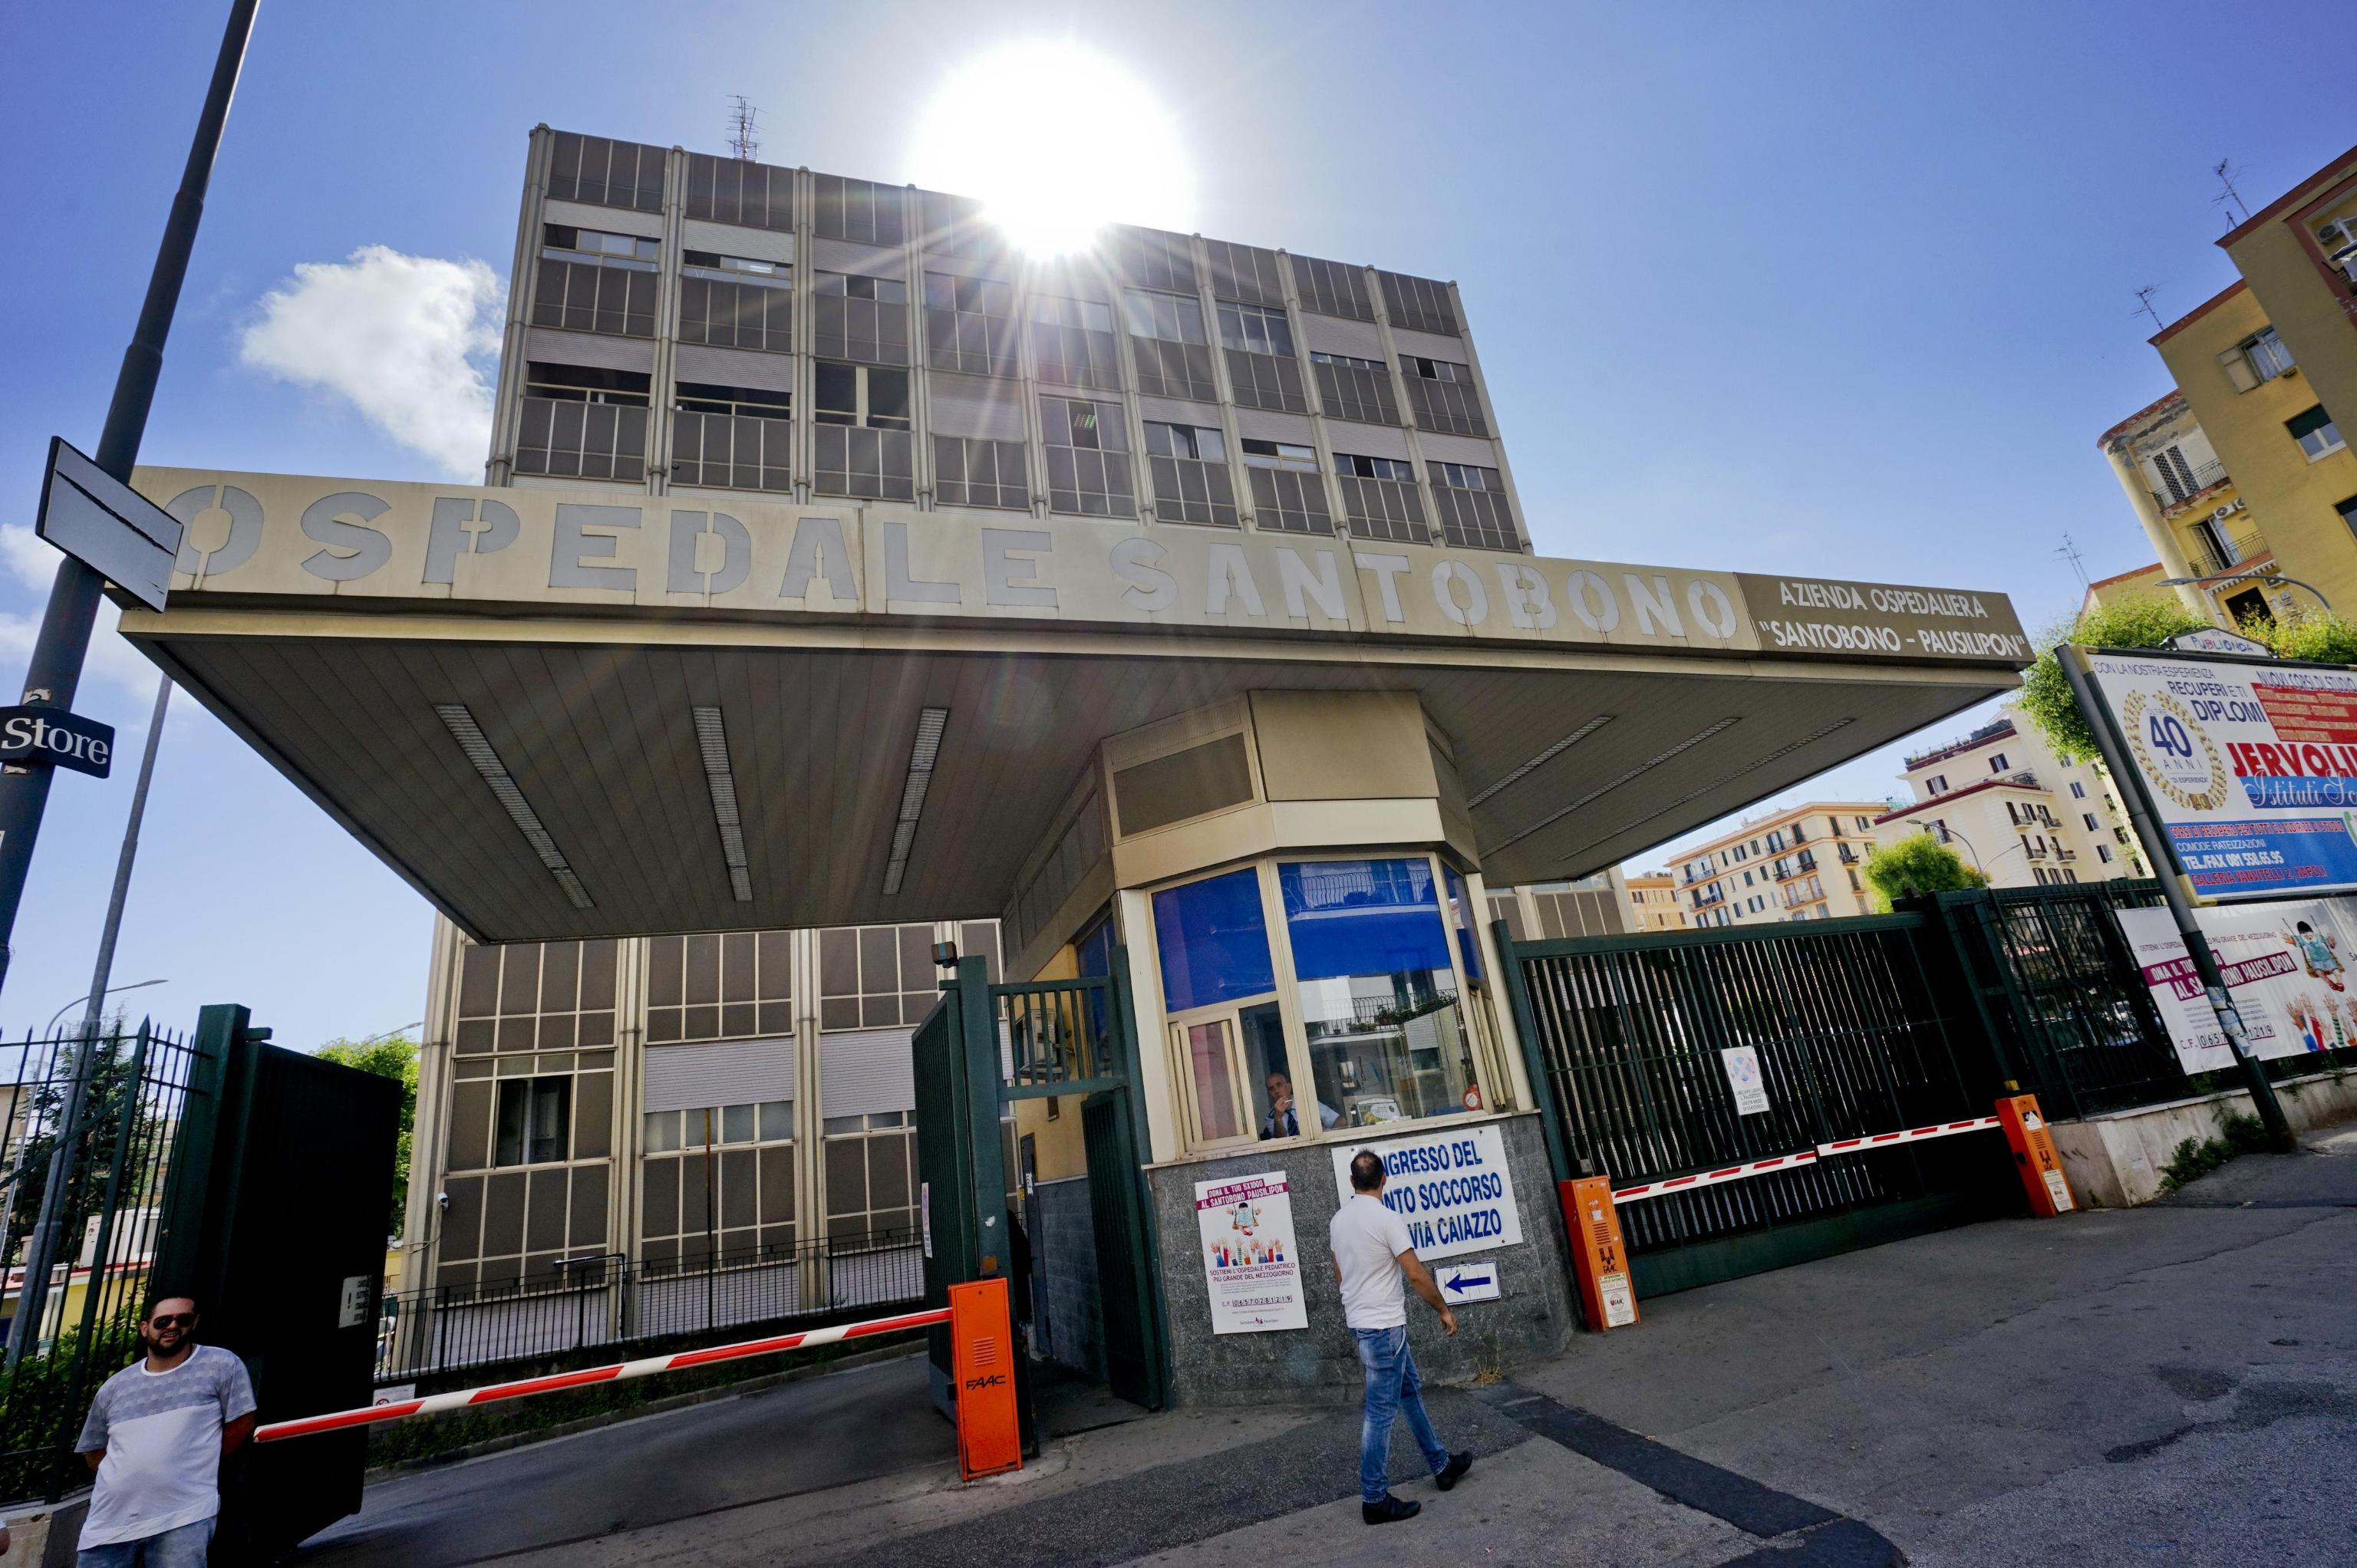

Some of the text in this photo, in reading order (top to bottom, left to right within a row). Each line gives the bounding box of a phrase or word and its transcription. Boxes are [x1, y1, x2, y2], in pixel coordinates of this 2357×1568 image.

[163, 484, 1738, 640] OSPEDALE SANTOBONO
[1779, 581, 1989, 619] AZIENDA OSPEDALIERA
[1759, 621, 1902, 653] "SANTOBONO
[1918, 629, 2025, 657] PAUSILIPON"
[2190, 635, 2254, 652] PUBLIONDA
[2094, 662, 2216, 679] CON LA NOSTRA ESPERIENZA
[2256, 670, 2289, 689] NUOVI
[2288, 674, 2314, 690] CORSI
[2167, 681, 2228, 697] RECUPERI
[2191, 700, 2267, 723] DIPLOMI
[1, 717, 109, 765] Store
[2149, 715, 2193, 758] 40
[2163, 759, 2204, 770] ANNI
[2244, 769, 2322, 805] Istituti
[2170, 825, 2191, 838] CORSI
[2199, 824, 2237, 838] RECUPERO
[2176, 838, 2266, 852] COMODE RATEIZZAZIONI
[2225, 853, 2244, 868] 081
[2191, 871, 2237, 886] GALLERIA
[2234, 868, 2284, 884] VANVITELLI
[2295, 865, 2328, 879] NAPOLI
[2170, 963, 2183, 977] IL
[2174, 980, 2194, 999] AL
[2243, 953, 2296, 982] PAUSILIPON
[1382, 1140, 1483, 1178] NGRESSO DEL
[1201, 1184, 1284, 1209] AL SANTOBONO PAUSILIPON
[1208, 1188, 1223, 1199] DONA
[1223, 1186, 1230, 1196] IL
[1231, 1184, 1242, 1194] TUO
[1419, 1171, 1502, 1211] SOCCORSO
[1406, 1208, 1502, 1250] VIA CAIAZZO
[1222, 1273, 1244, 1282] GRANDE
[1244, 1272, 1255, 1280] DEL
[1255, 1270, 1294, 1279] MEZZOGIORNO
[1232, 1265, 1264, 1274] L'OSPEDALE
[1264, 1262, 1296, 1271] PEDIATRICO
[1603, 1263, 1617, 1274] FAAC
[965, 1375, 1007, 1391] FAAC
